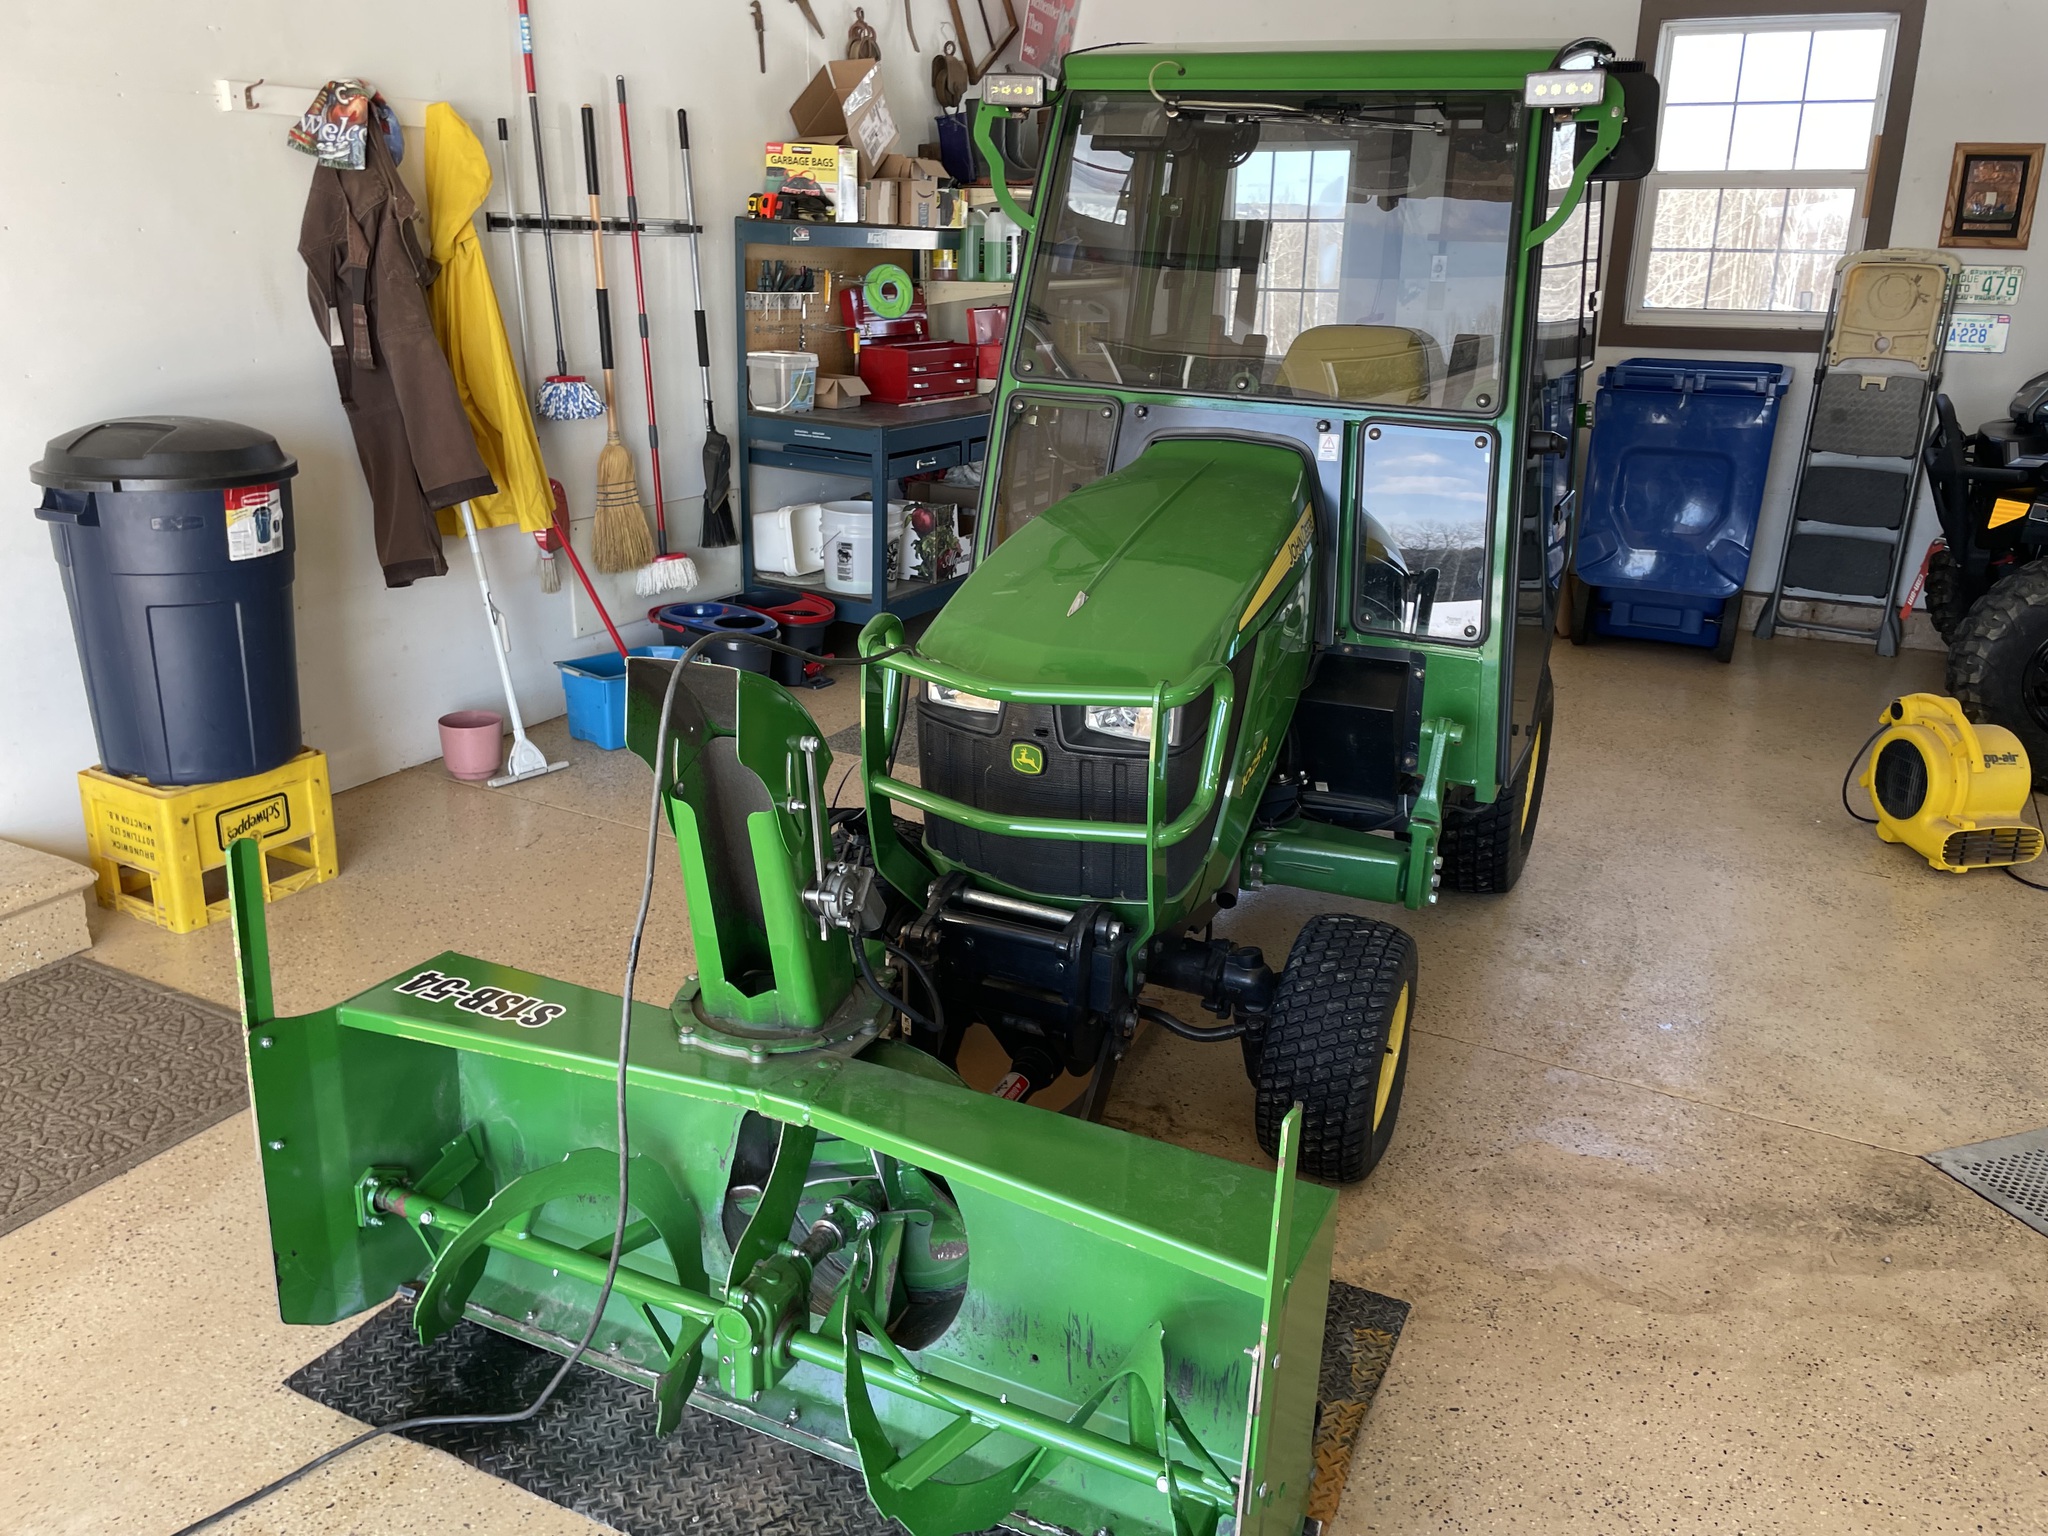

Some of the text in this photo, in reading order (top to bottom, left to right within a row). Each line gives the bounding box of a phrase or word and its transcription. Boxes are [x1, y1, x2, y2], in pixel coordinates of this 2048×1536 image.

[770, 155, 834, 168] GARBAGE BAGS
[1981, 275, 2019, 297] 479
[121, 815, 153, 832] MONCTON
[227, 801, 280, 841] Schweppes
[121, 829, 155, 848] BOTTLING
[111, 839, 155, 861] BRUNSWICK
